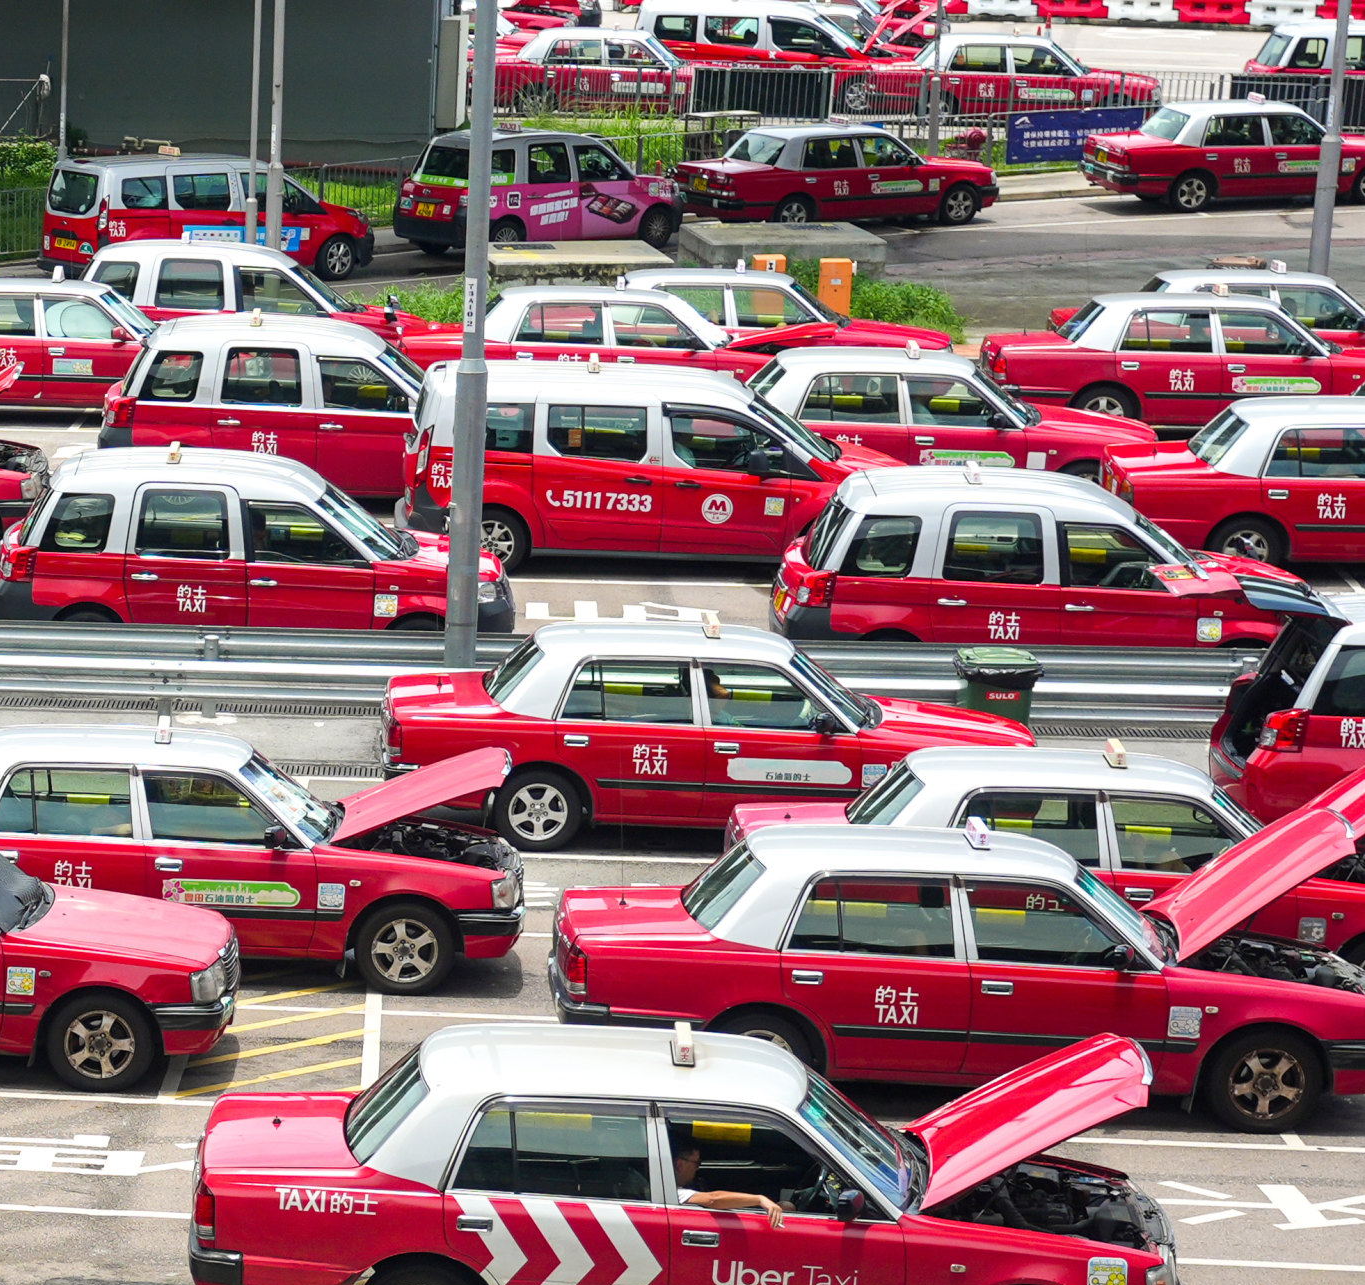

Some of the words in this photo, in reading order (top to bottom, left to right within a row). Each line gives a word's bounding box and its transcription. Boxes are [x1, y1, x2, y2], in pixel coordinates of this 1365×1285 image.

[490, 175, 508, 183] POAD
[834, 187, 849, 196] TAXI
[109, 220, 126, 229] 的士
[109, 229, 126, 238] TAXI
[1169, 369, 1195, 380] 的士
[1169, 380, 1195, 391] TAXI
[252, 431, 277, 443] 的士
[251, 442, 278, 455] TAXI
[562, 490, 601, 510] 5111
[605, 492, 653, 513] 7333
[708, 499, 727, 512] M
[1318, 493, 1346, 506] 的士
[1317, 506, 1346, 520] TAXI
[176, 585, 206, 598] 的士
[176, 598, 206, 612] TAXI
[988, 611, 1020, 625] 的士
[988, 625, 1020, 640] TAXI
[633, 744, 668, 760] 的士
[632, 759, 667, 775] TAXI
[54, 860, 92, 877] 的士
[54, 876, 92, 888] TAXI
[184, 893, 255, 904] 豐田石油氣的士
[875, 985, 919, 1005] 的士
[875, 1004, 918, 1025] TAXI
[275, 1188, 326, 1213] TAXI
[330, 1191, 379, 1216] 的士
